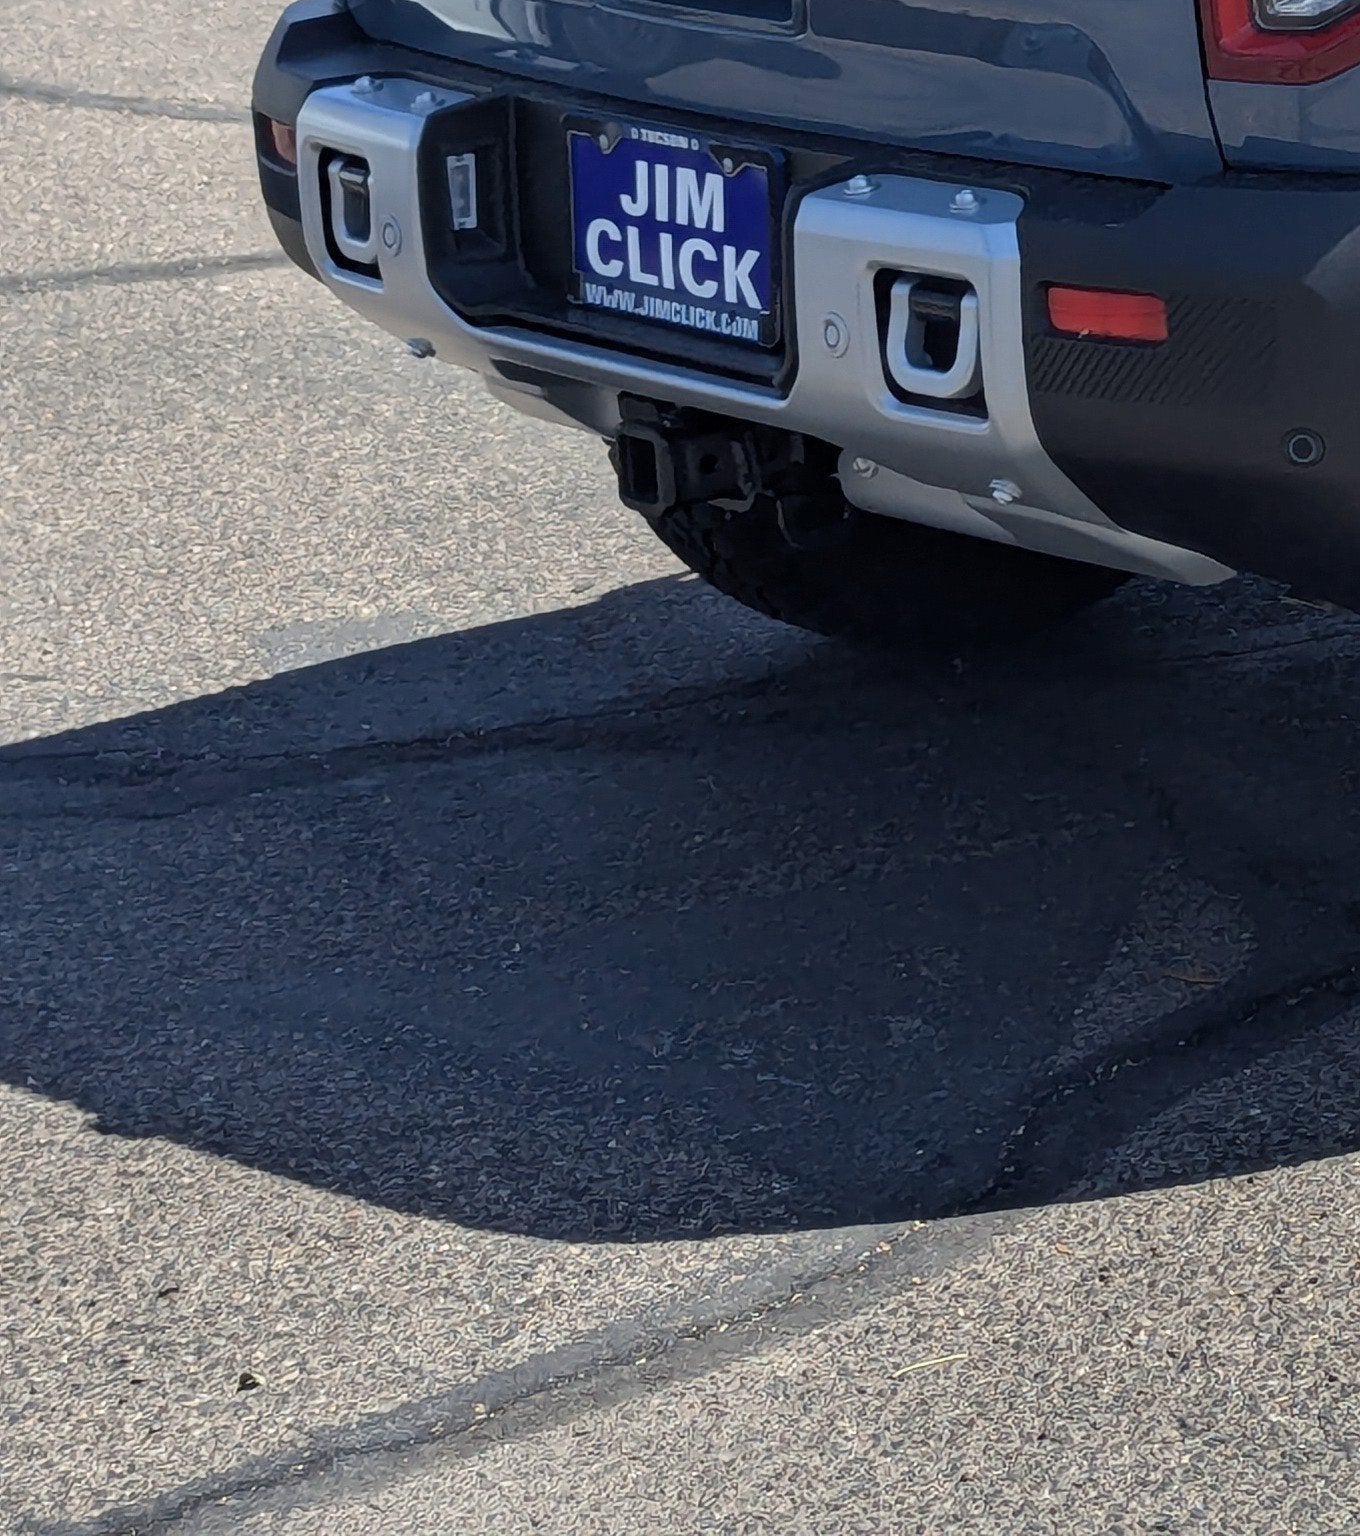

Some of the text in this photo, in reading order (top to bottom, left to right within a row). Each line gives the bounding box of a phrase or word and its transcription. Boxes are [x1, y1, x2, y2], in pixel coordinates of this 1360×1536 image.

[619, 159, 725, 233] JIM
[585, 217, 763, 310] CLICK
[584, 281, 760, 342] WWW.JIMCLICK.COM
